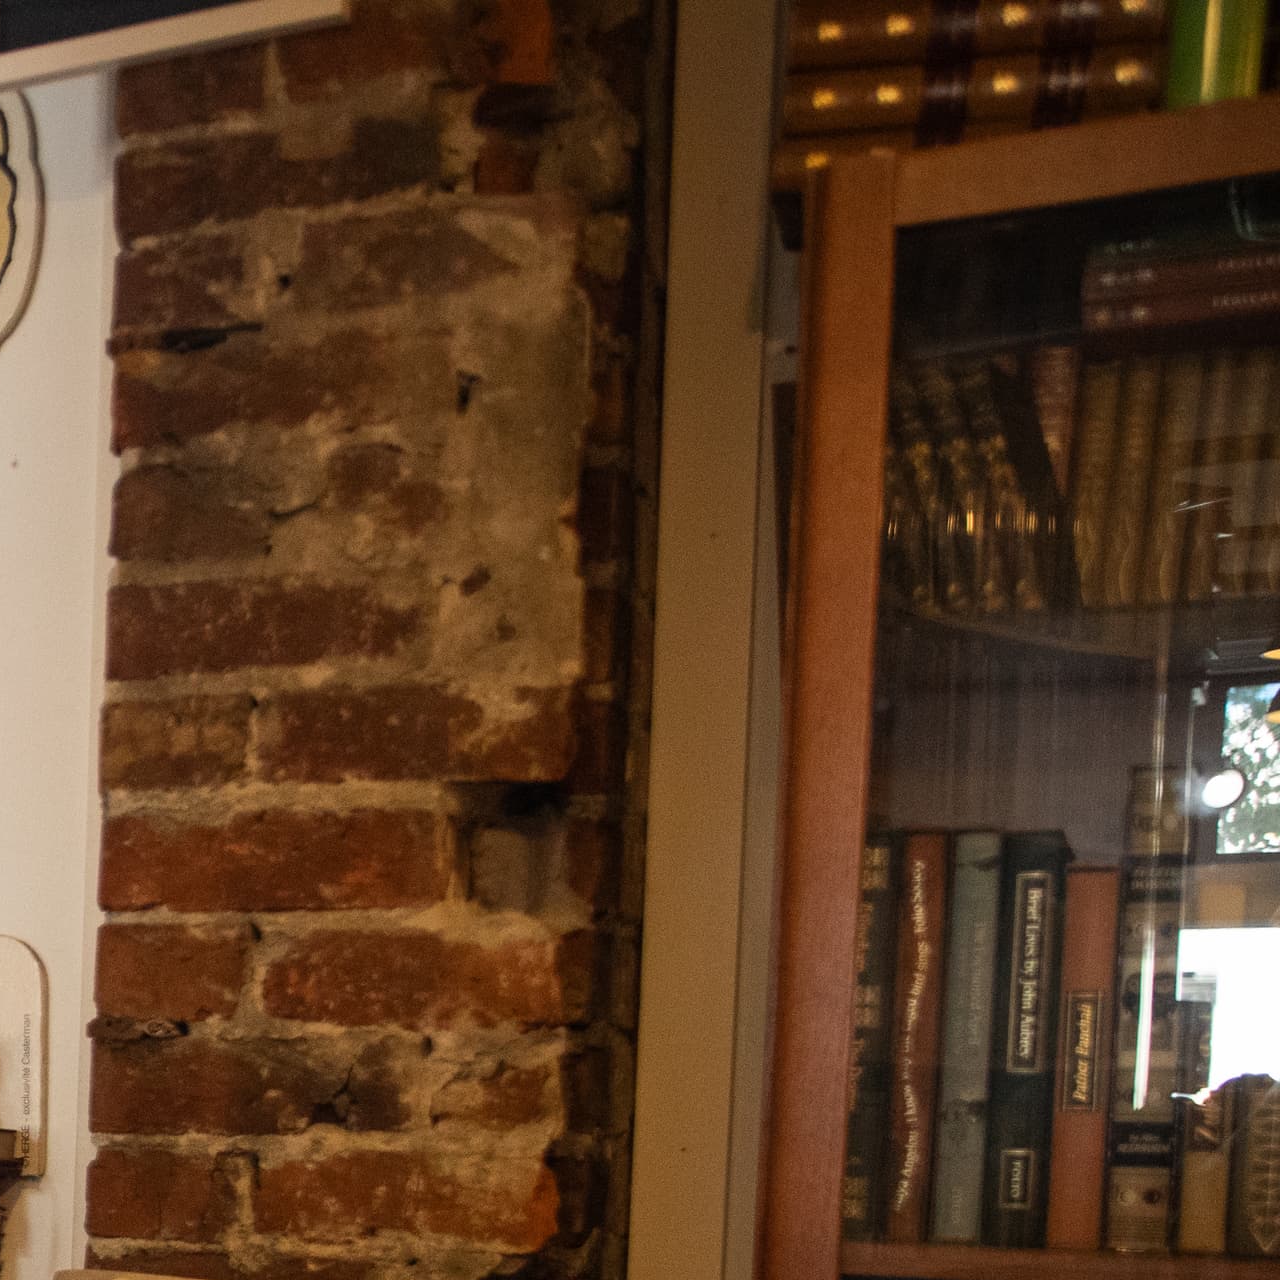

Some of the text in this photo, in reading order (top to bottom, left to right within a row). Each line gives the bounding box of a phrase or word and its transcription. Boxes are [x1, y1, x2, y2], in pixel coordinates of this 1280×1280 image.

[1026, 888, 1043, 922] Brief
[1024, 924, 1040, 958] Lives
[1020, 960, 1039, 976] by
[1019, 977, 1039, 1011] John
[21, 1013, 32, 1066] Casterman
